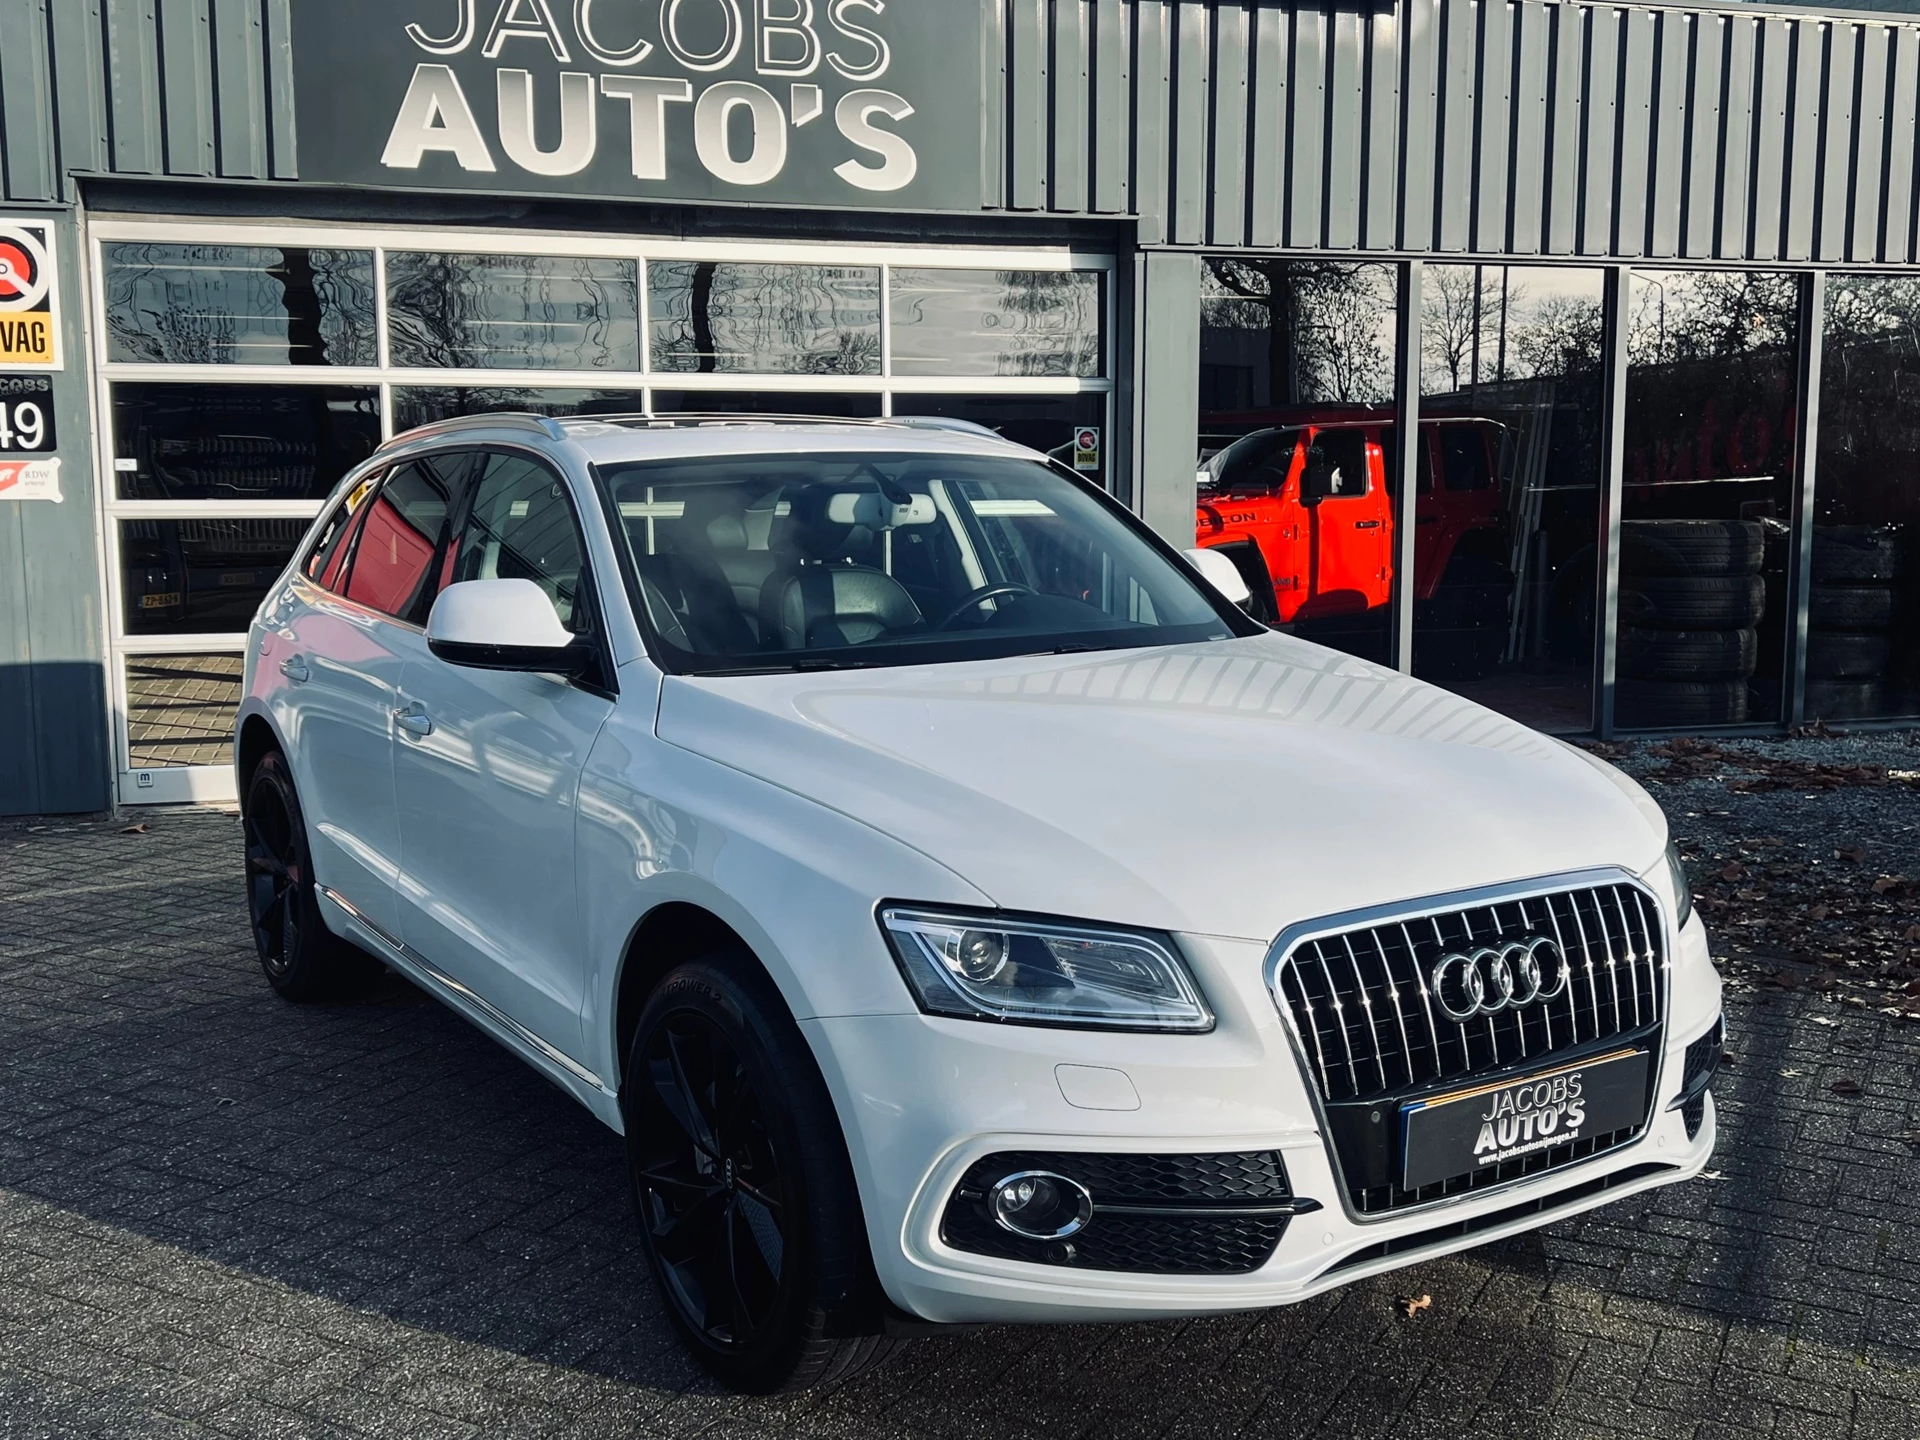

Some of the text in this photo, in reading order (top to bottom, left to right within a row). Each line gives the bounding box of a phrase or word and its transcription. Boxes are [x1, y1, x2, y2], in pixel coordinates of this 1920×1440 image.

[404, 0, 891, 82] JACOBS
[379, 63, 917, 191] AUTO'S
[25, 470, 50, 479] RDW
[1481, 1072, 1582, 1121] JACOBS
[1473, 1098, 1586, 1155] AUTO'S
[1478, 1127, 1579, 1166] www.jacobsautosnijmegen.nl
